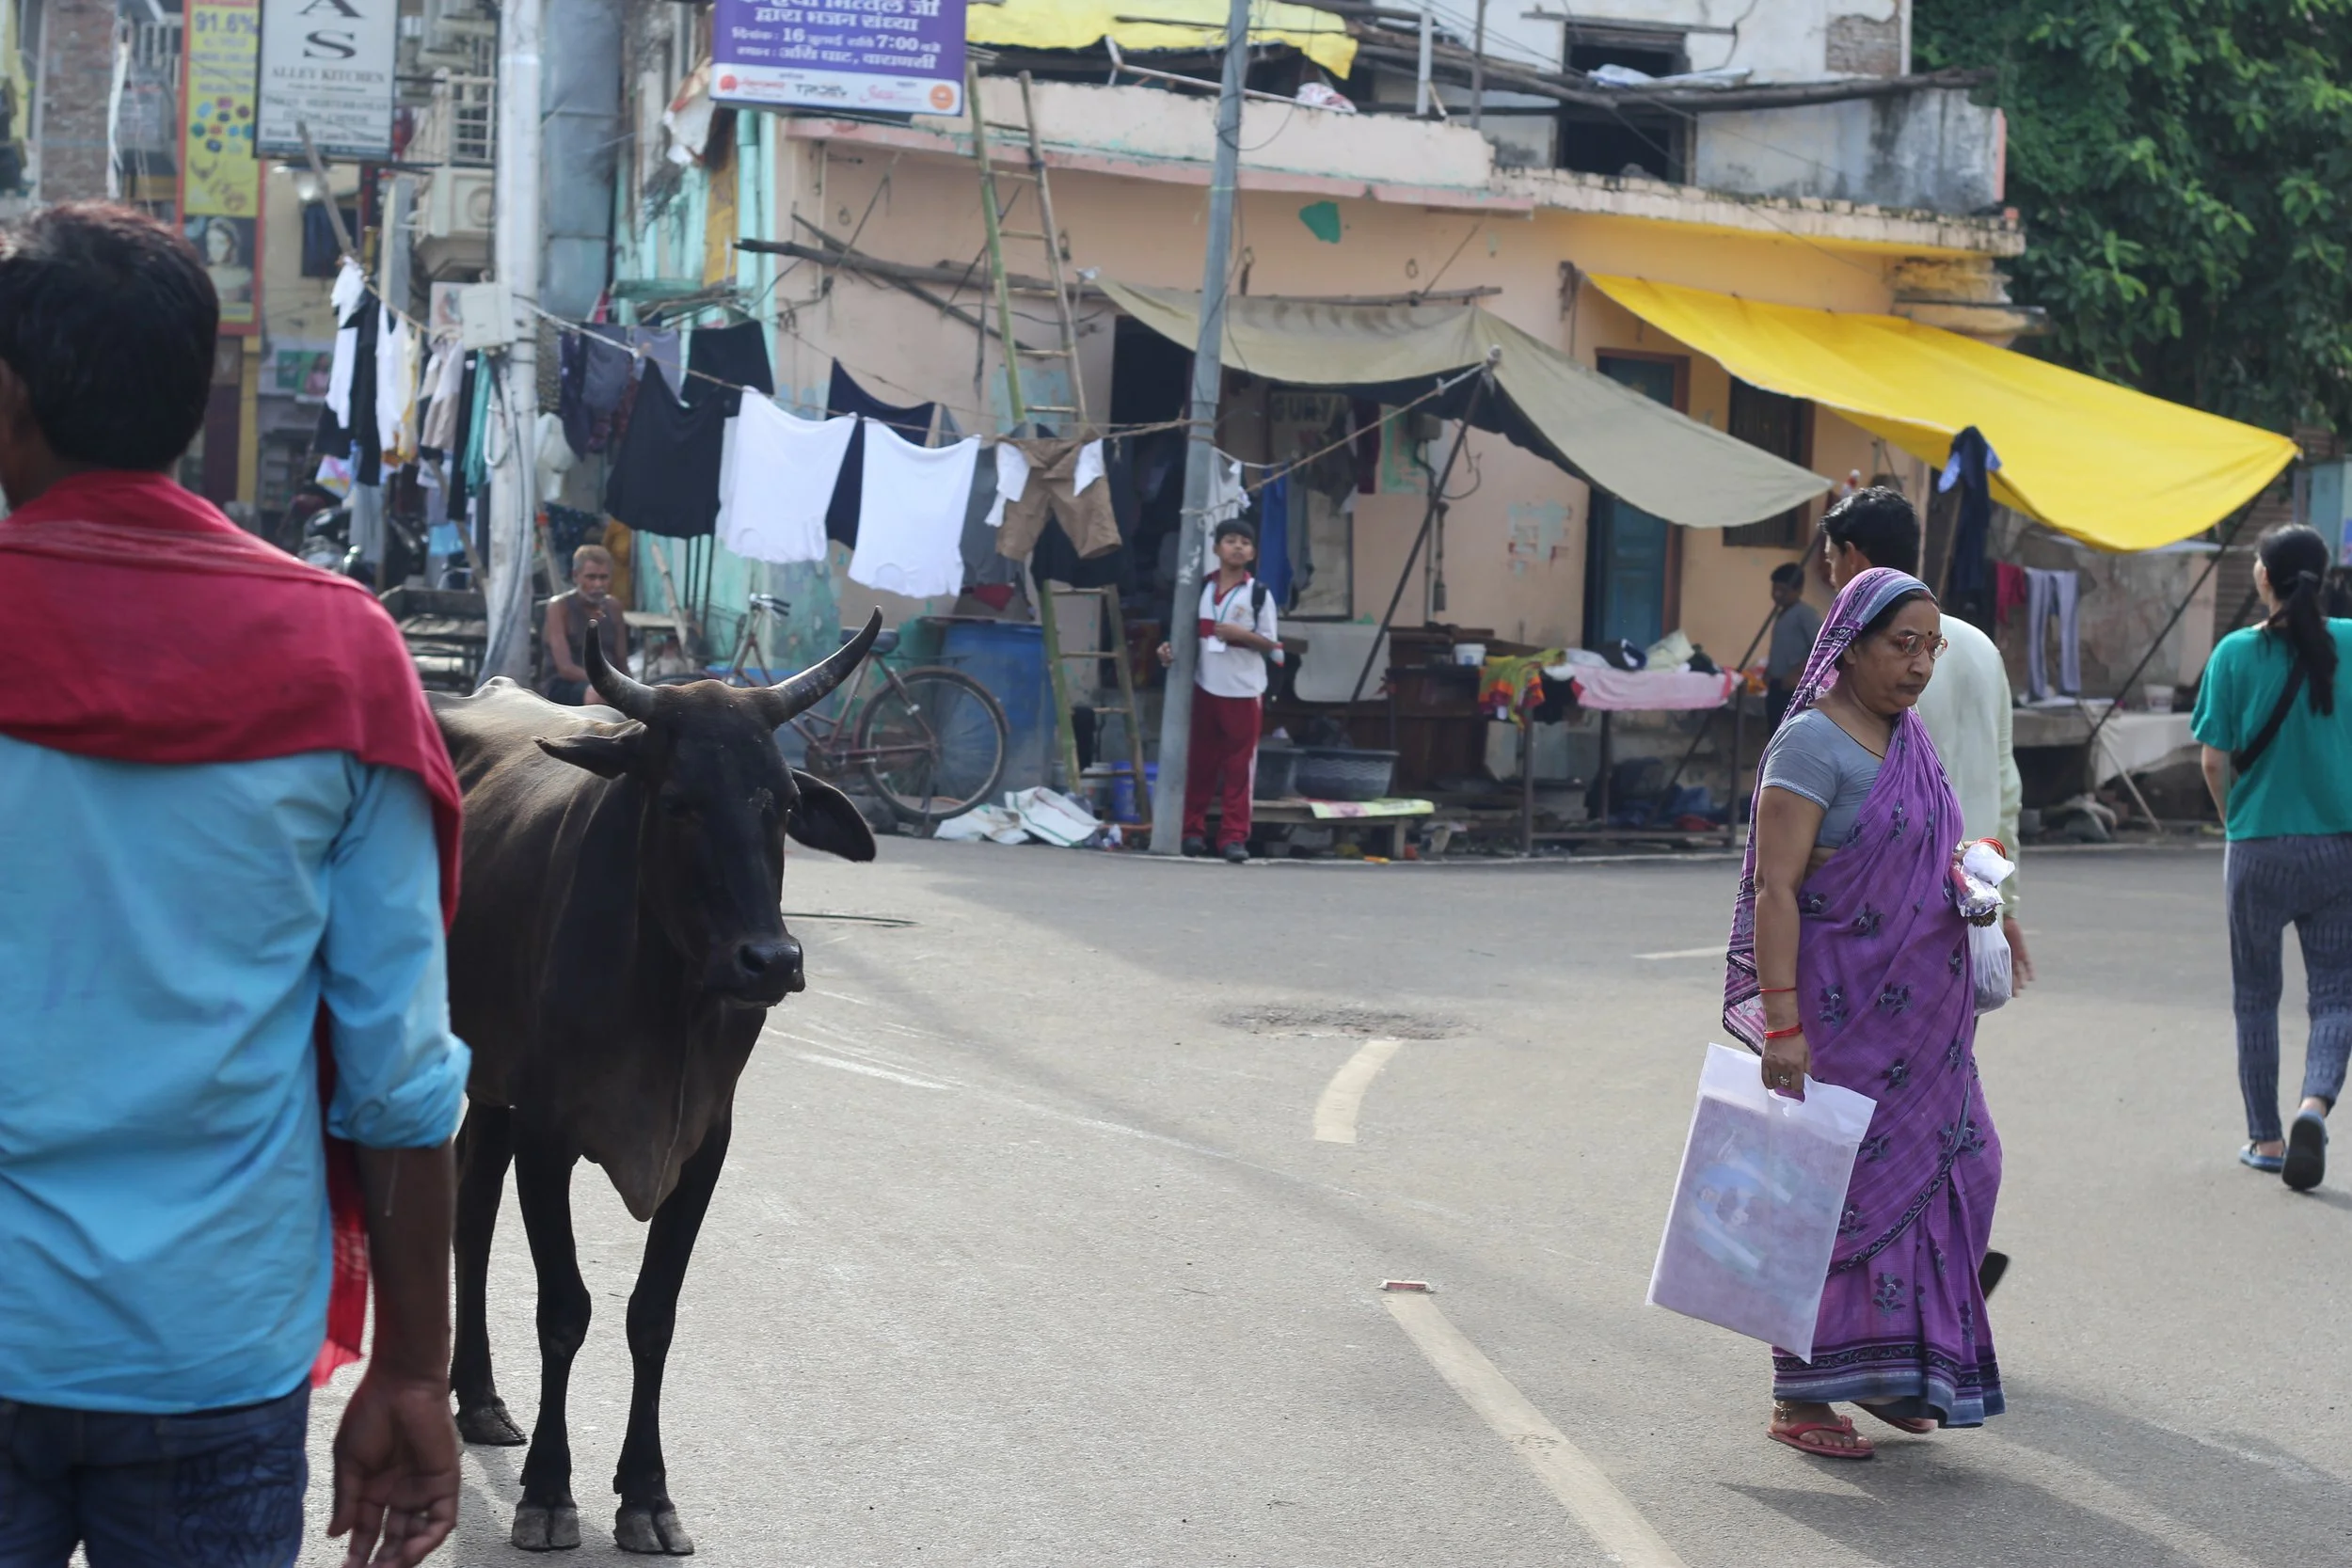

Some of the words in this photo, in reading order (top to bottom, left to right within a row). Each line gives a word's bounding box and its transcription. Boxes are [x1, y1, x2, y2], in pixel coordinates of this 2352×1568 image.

[806, 10, 857, 27] भजन
[861, 11, 919, 32] संध्या
[303, 29, 356, 60] S
[783, 27, 806, 43] 16
[876, 34, 919, 51] 7:00
[862, 53, 937, 70] वाराणसी
[272, 66, 317, 80] ALLEY
[321, 68, 386, 84] KITCHEN
